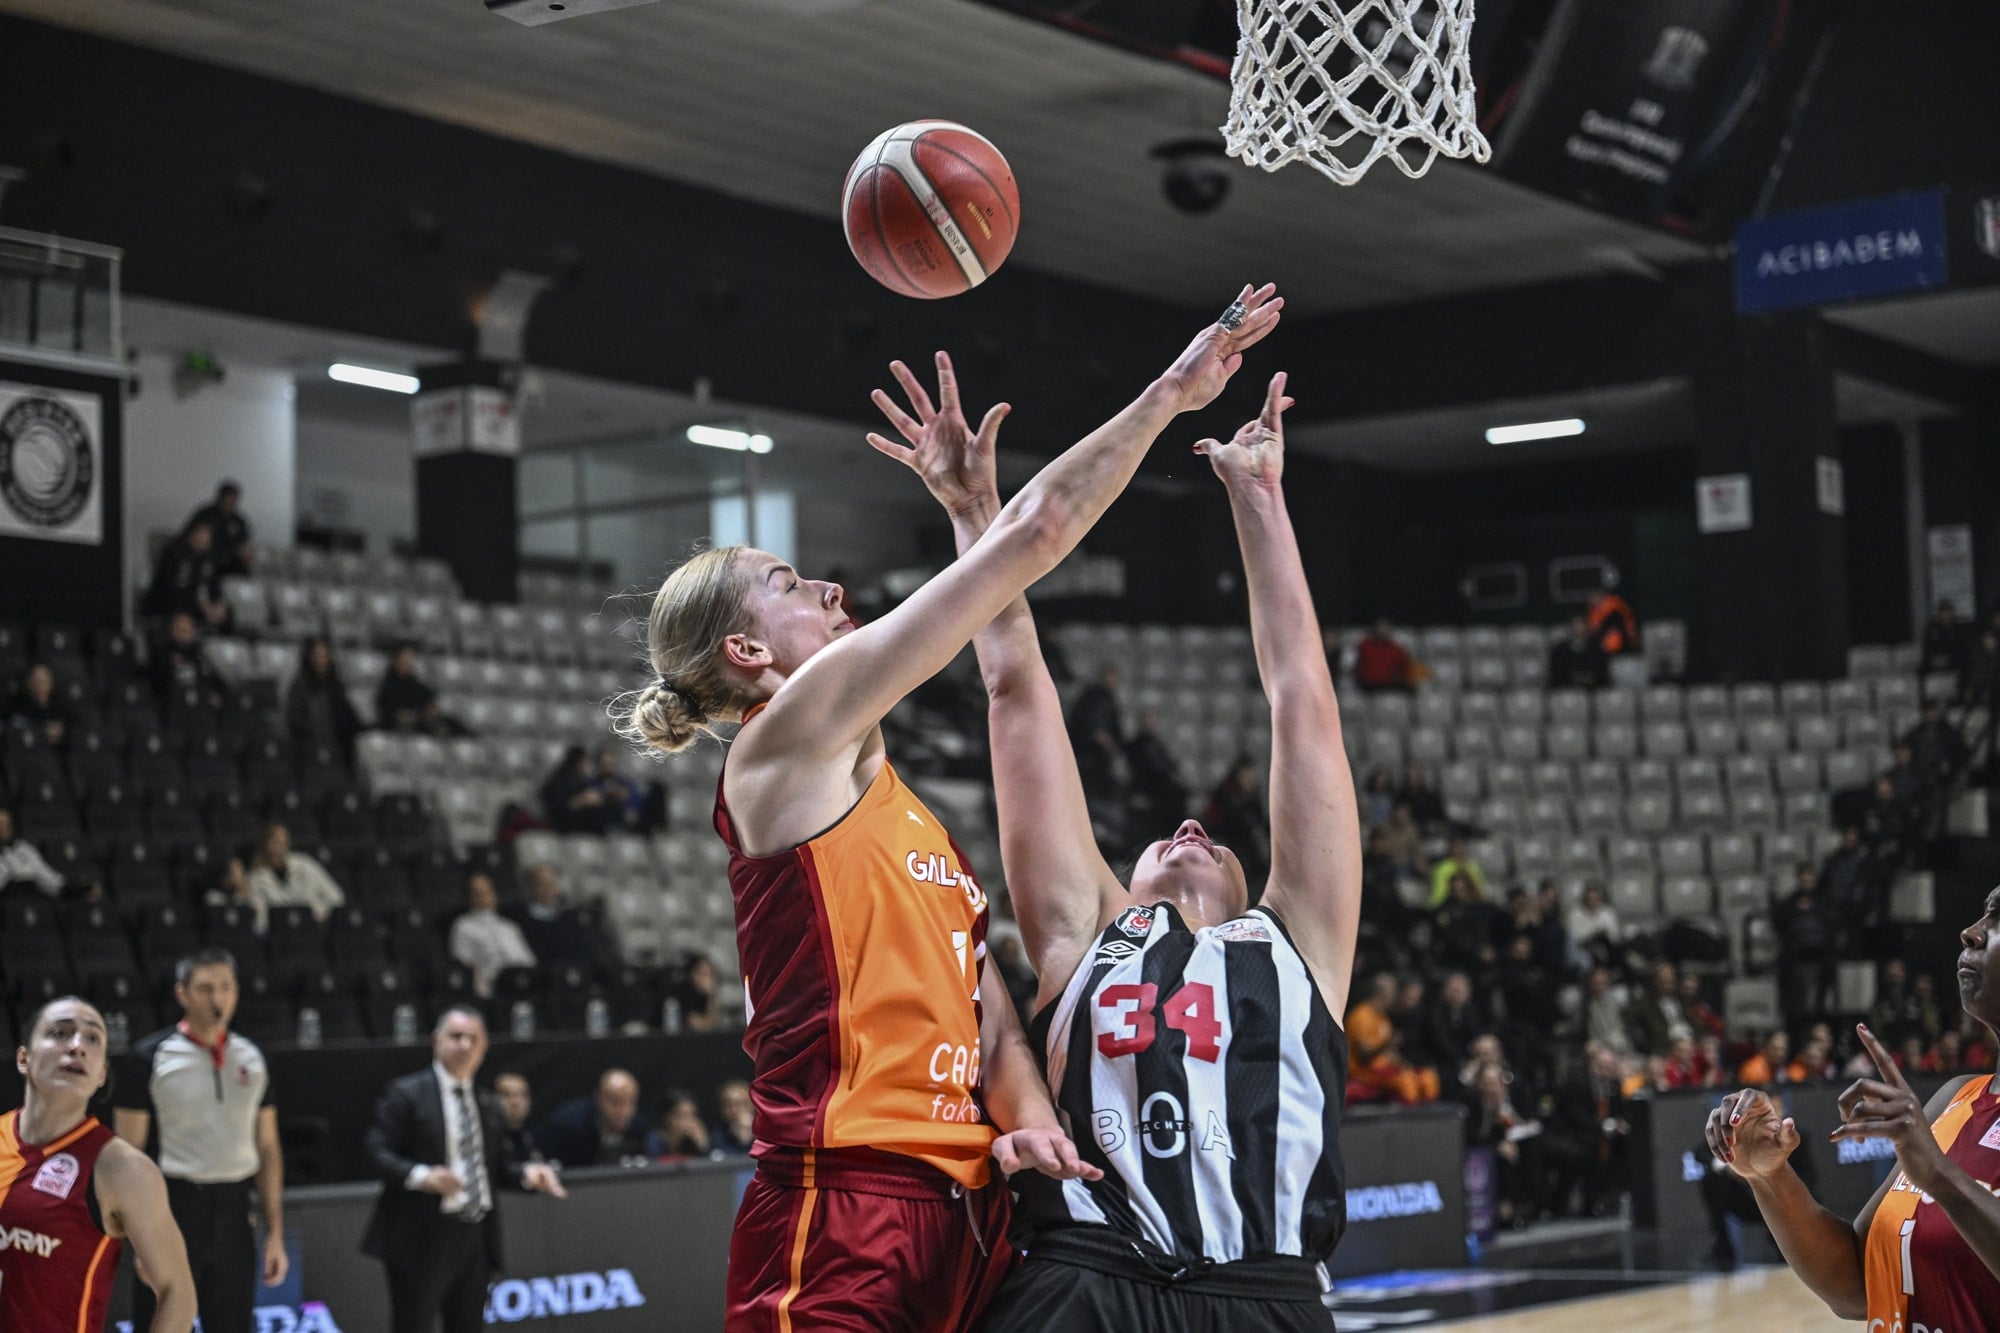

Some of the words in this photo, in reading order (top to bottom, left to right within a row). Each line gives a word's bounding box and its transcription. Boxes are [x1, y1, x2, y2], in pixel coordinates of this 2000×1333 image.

[1097, 981, 1222, 1064] 34
[1134, 1121, 1194, 1134] YACHTS
[483, 1268, 646, 1324] ONDA
